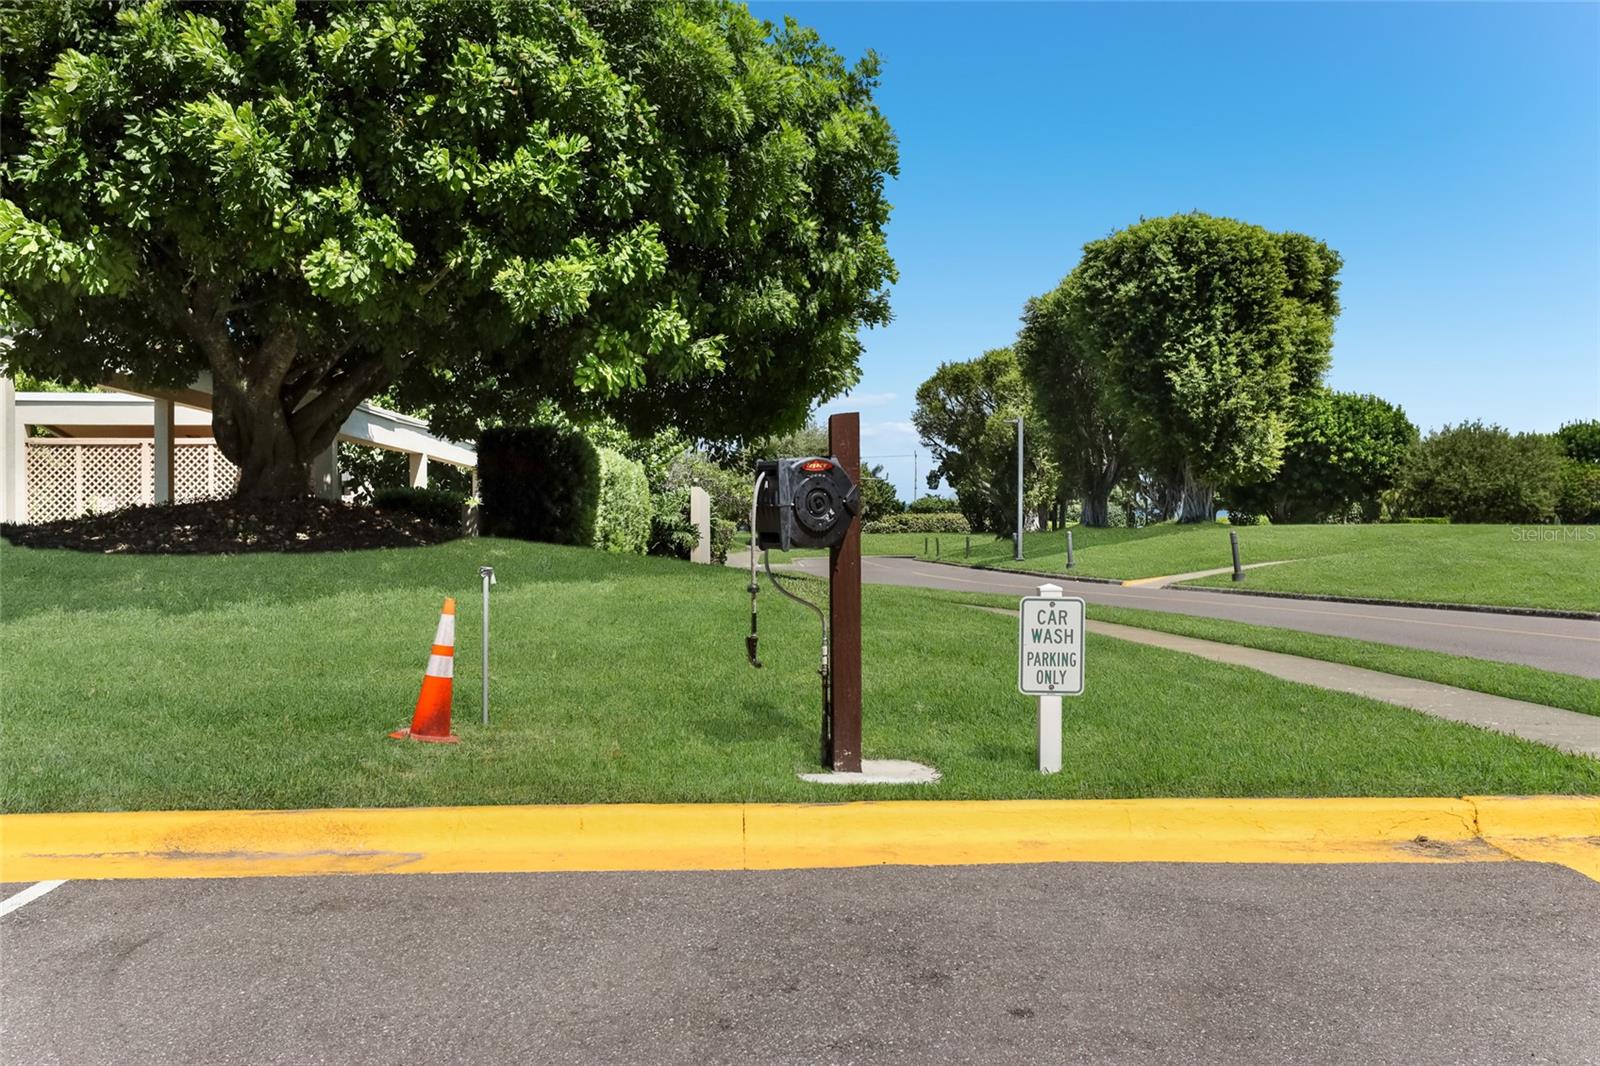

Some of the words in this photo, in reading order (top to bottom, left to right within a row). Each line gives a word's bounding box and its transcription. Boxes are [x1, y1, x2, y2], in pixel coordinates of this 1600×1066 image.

[1037, 609, 1068, 625] CAR
[1031, 628, 1074, 644] WASH
[1026, 651, 1077, 667] PARKING
[1036, 670, 1067, 685] ONLY
